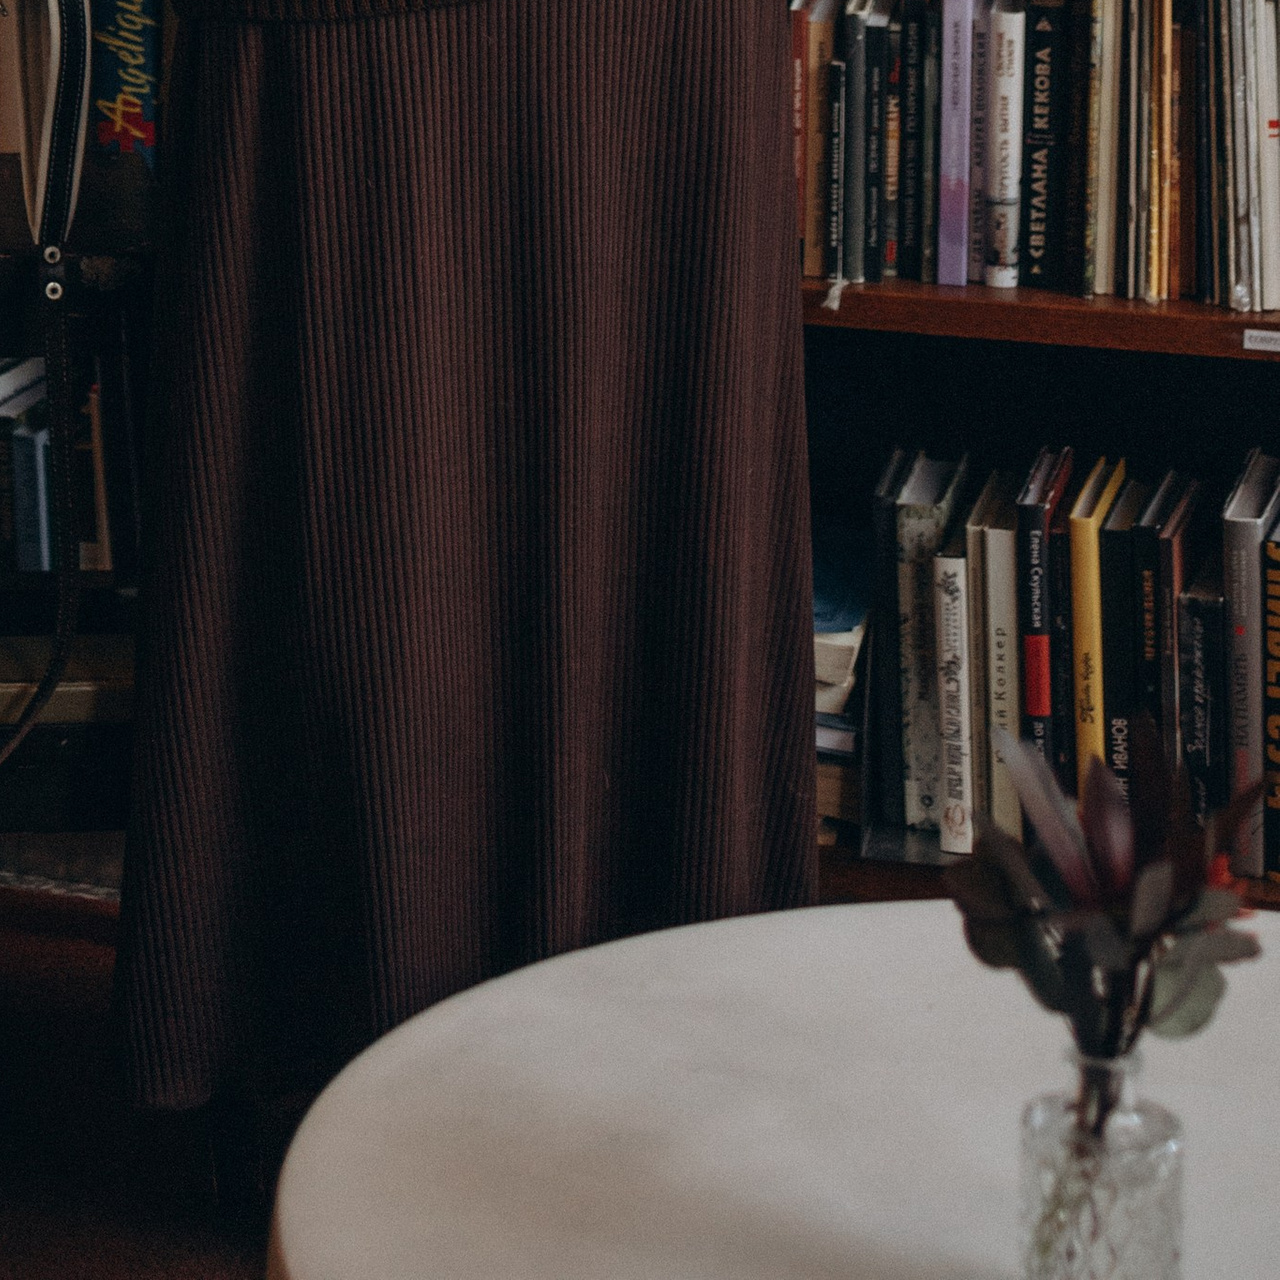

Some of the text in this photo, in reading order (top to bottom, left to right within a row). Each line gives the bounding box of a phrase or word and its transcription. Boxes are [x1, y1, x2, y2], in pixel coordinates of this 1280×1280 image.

[974, 32, 986, 167] АНДРЕЙ ПОЛОНСКИЙ
[1028, 46, 1053, 259] СВЕТЛАНА КЕКОВА
[1029, 529, 1043, 566] Елена
[1029, 567, 1043, 629] Скульская
[993, 627, 1007, 701] Колкер
[1234, 653, 1250, 717] ПАМЯТЬ
[1111, 718, 1129, 771] ИВАНОВ
[1234, 718, 1249, 748] НА
